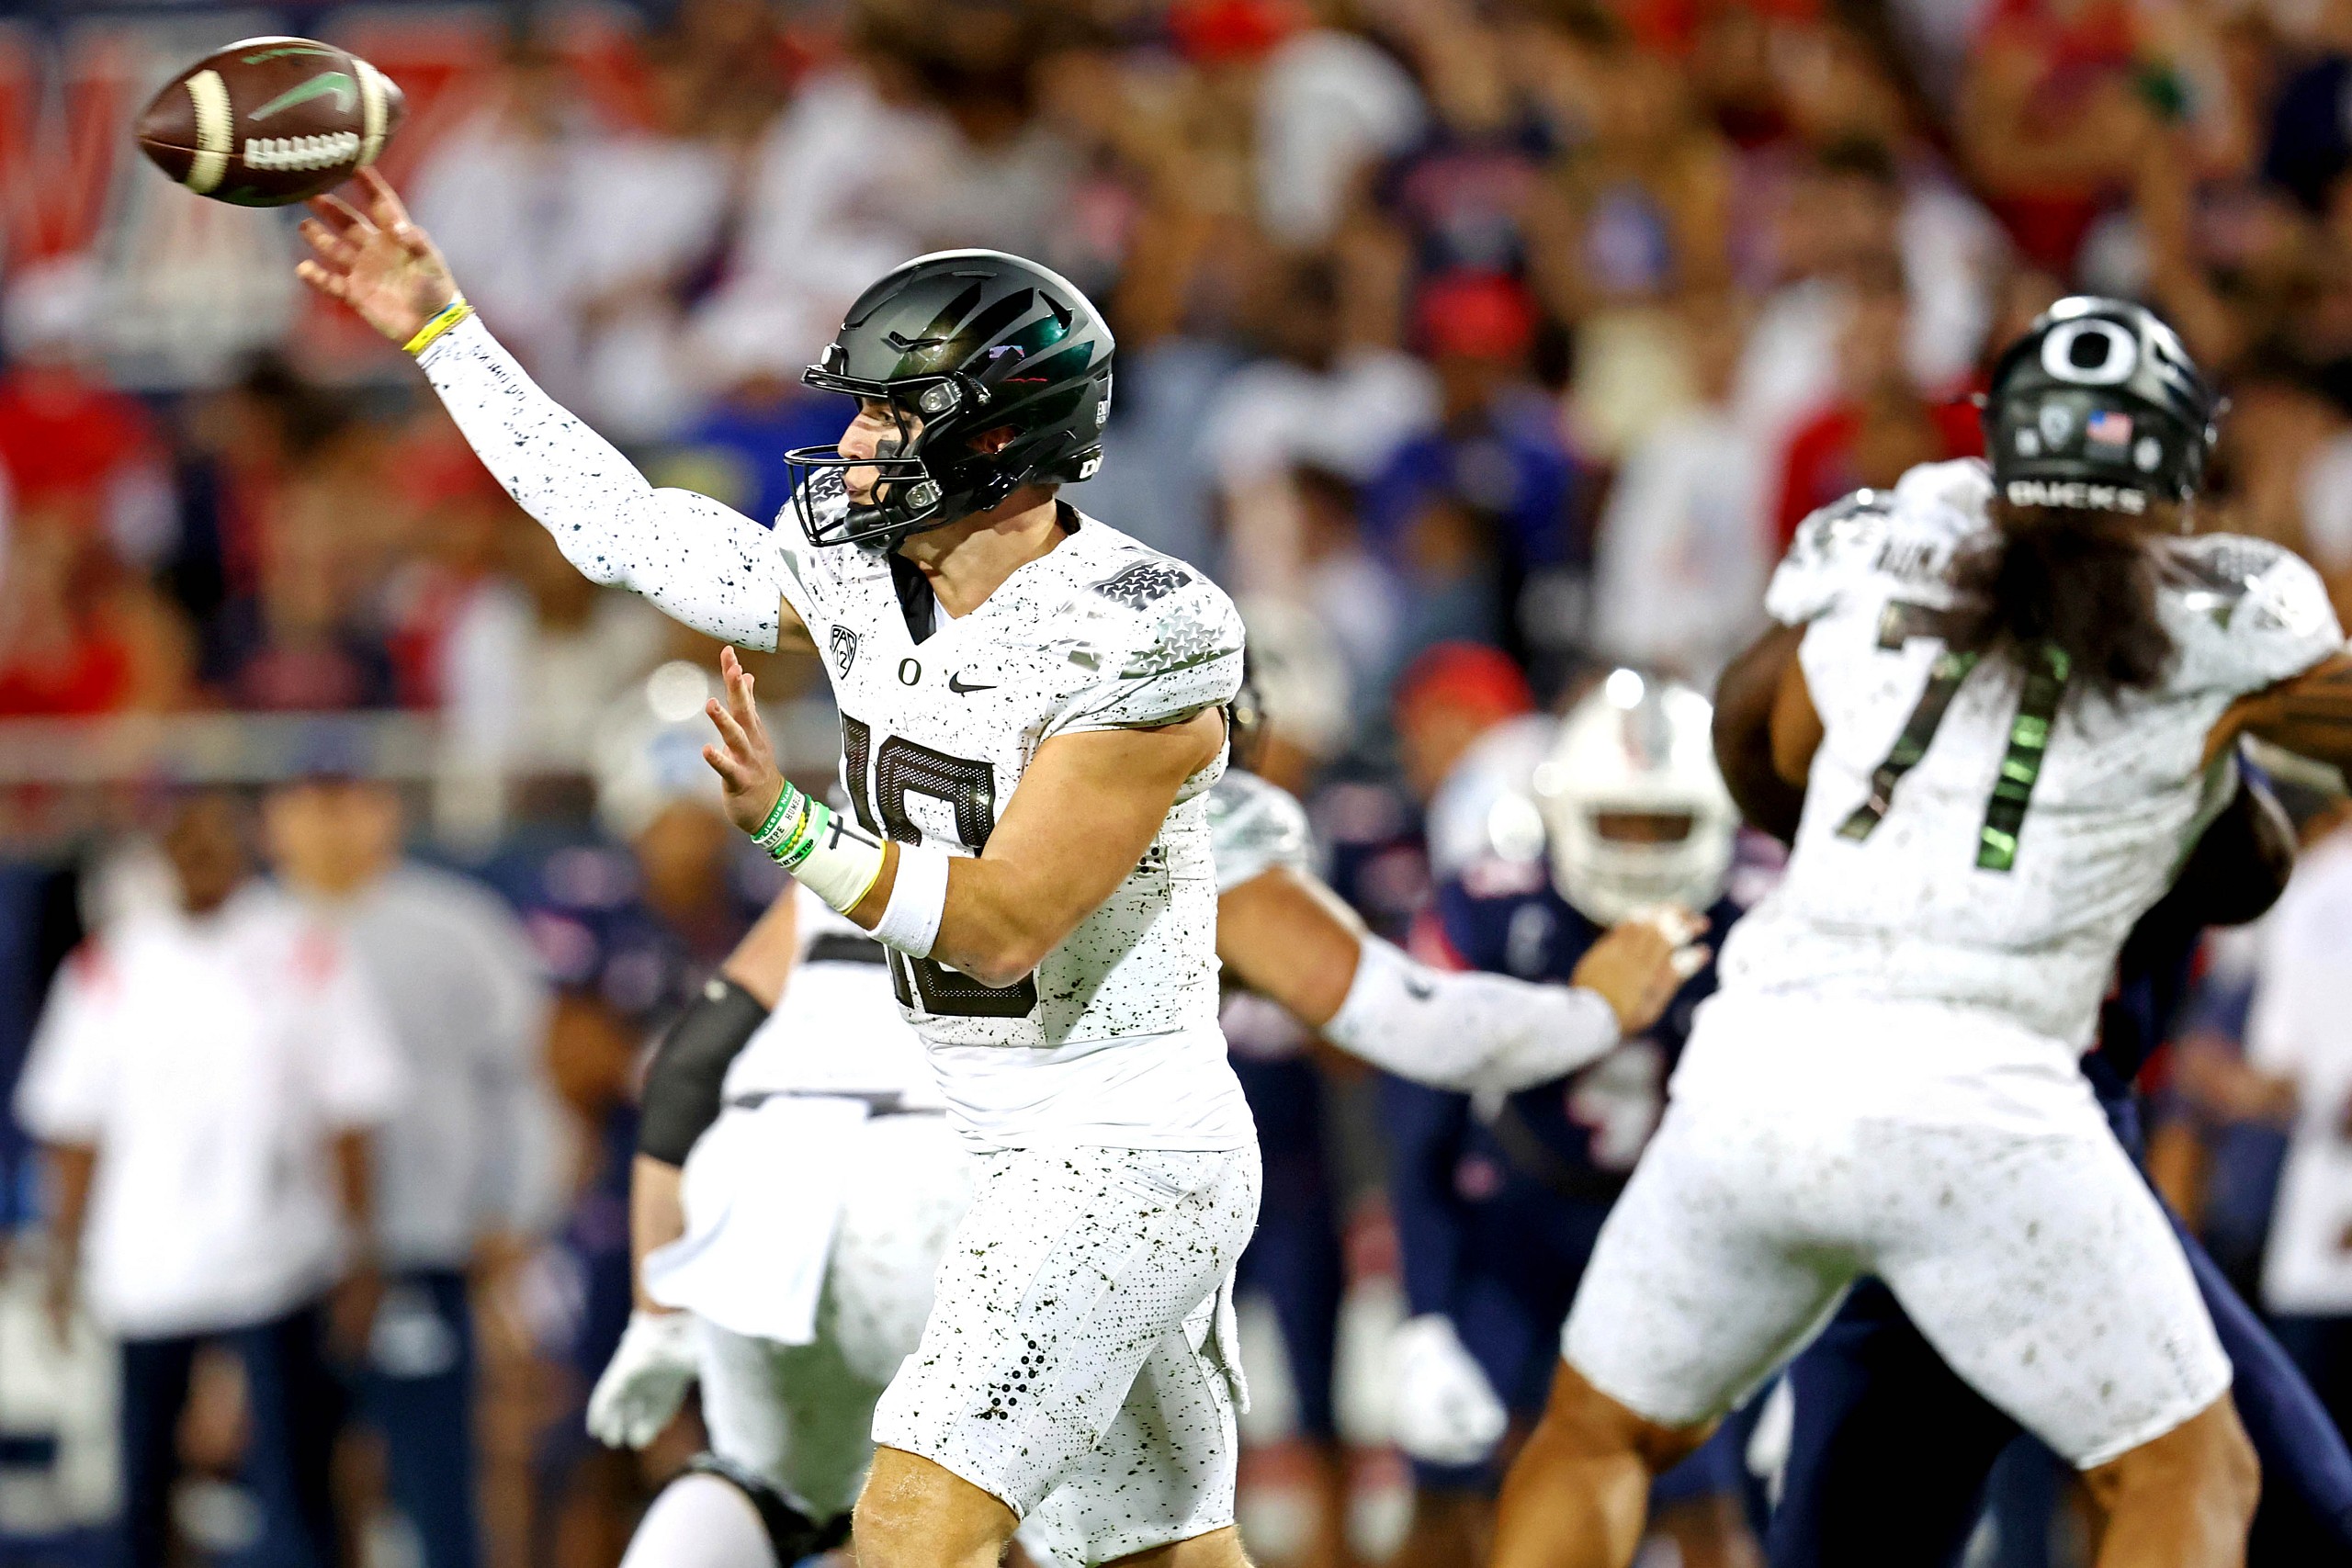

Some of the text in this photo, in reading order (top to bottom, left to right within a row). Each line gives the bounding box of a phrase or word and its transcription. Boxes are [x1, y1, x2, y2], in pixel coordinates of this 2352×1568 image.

[2041, 318, 2138, 385] O
[2007, 479, 2147, 515] DUCKS
[831, 627, 856, 660] PAC
[836, 649, 848, 671] 12
[898, 658, 922, 687] O
[1834, 600, 2072, 872] 71
[763, 806, 784, 835] JESUS
[764, 826, 785, 846] HYPE
[789, 851, 804, 862] THE
[801, 839, 814, 852] TOP
